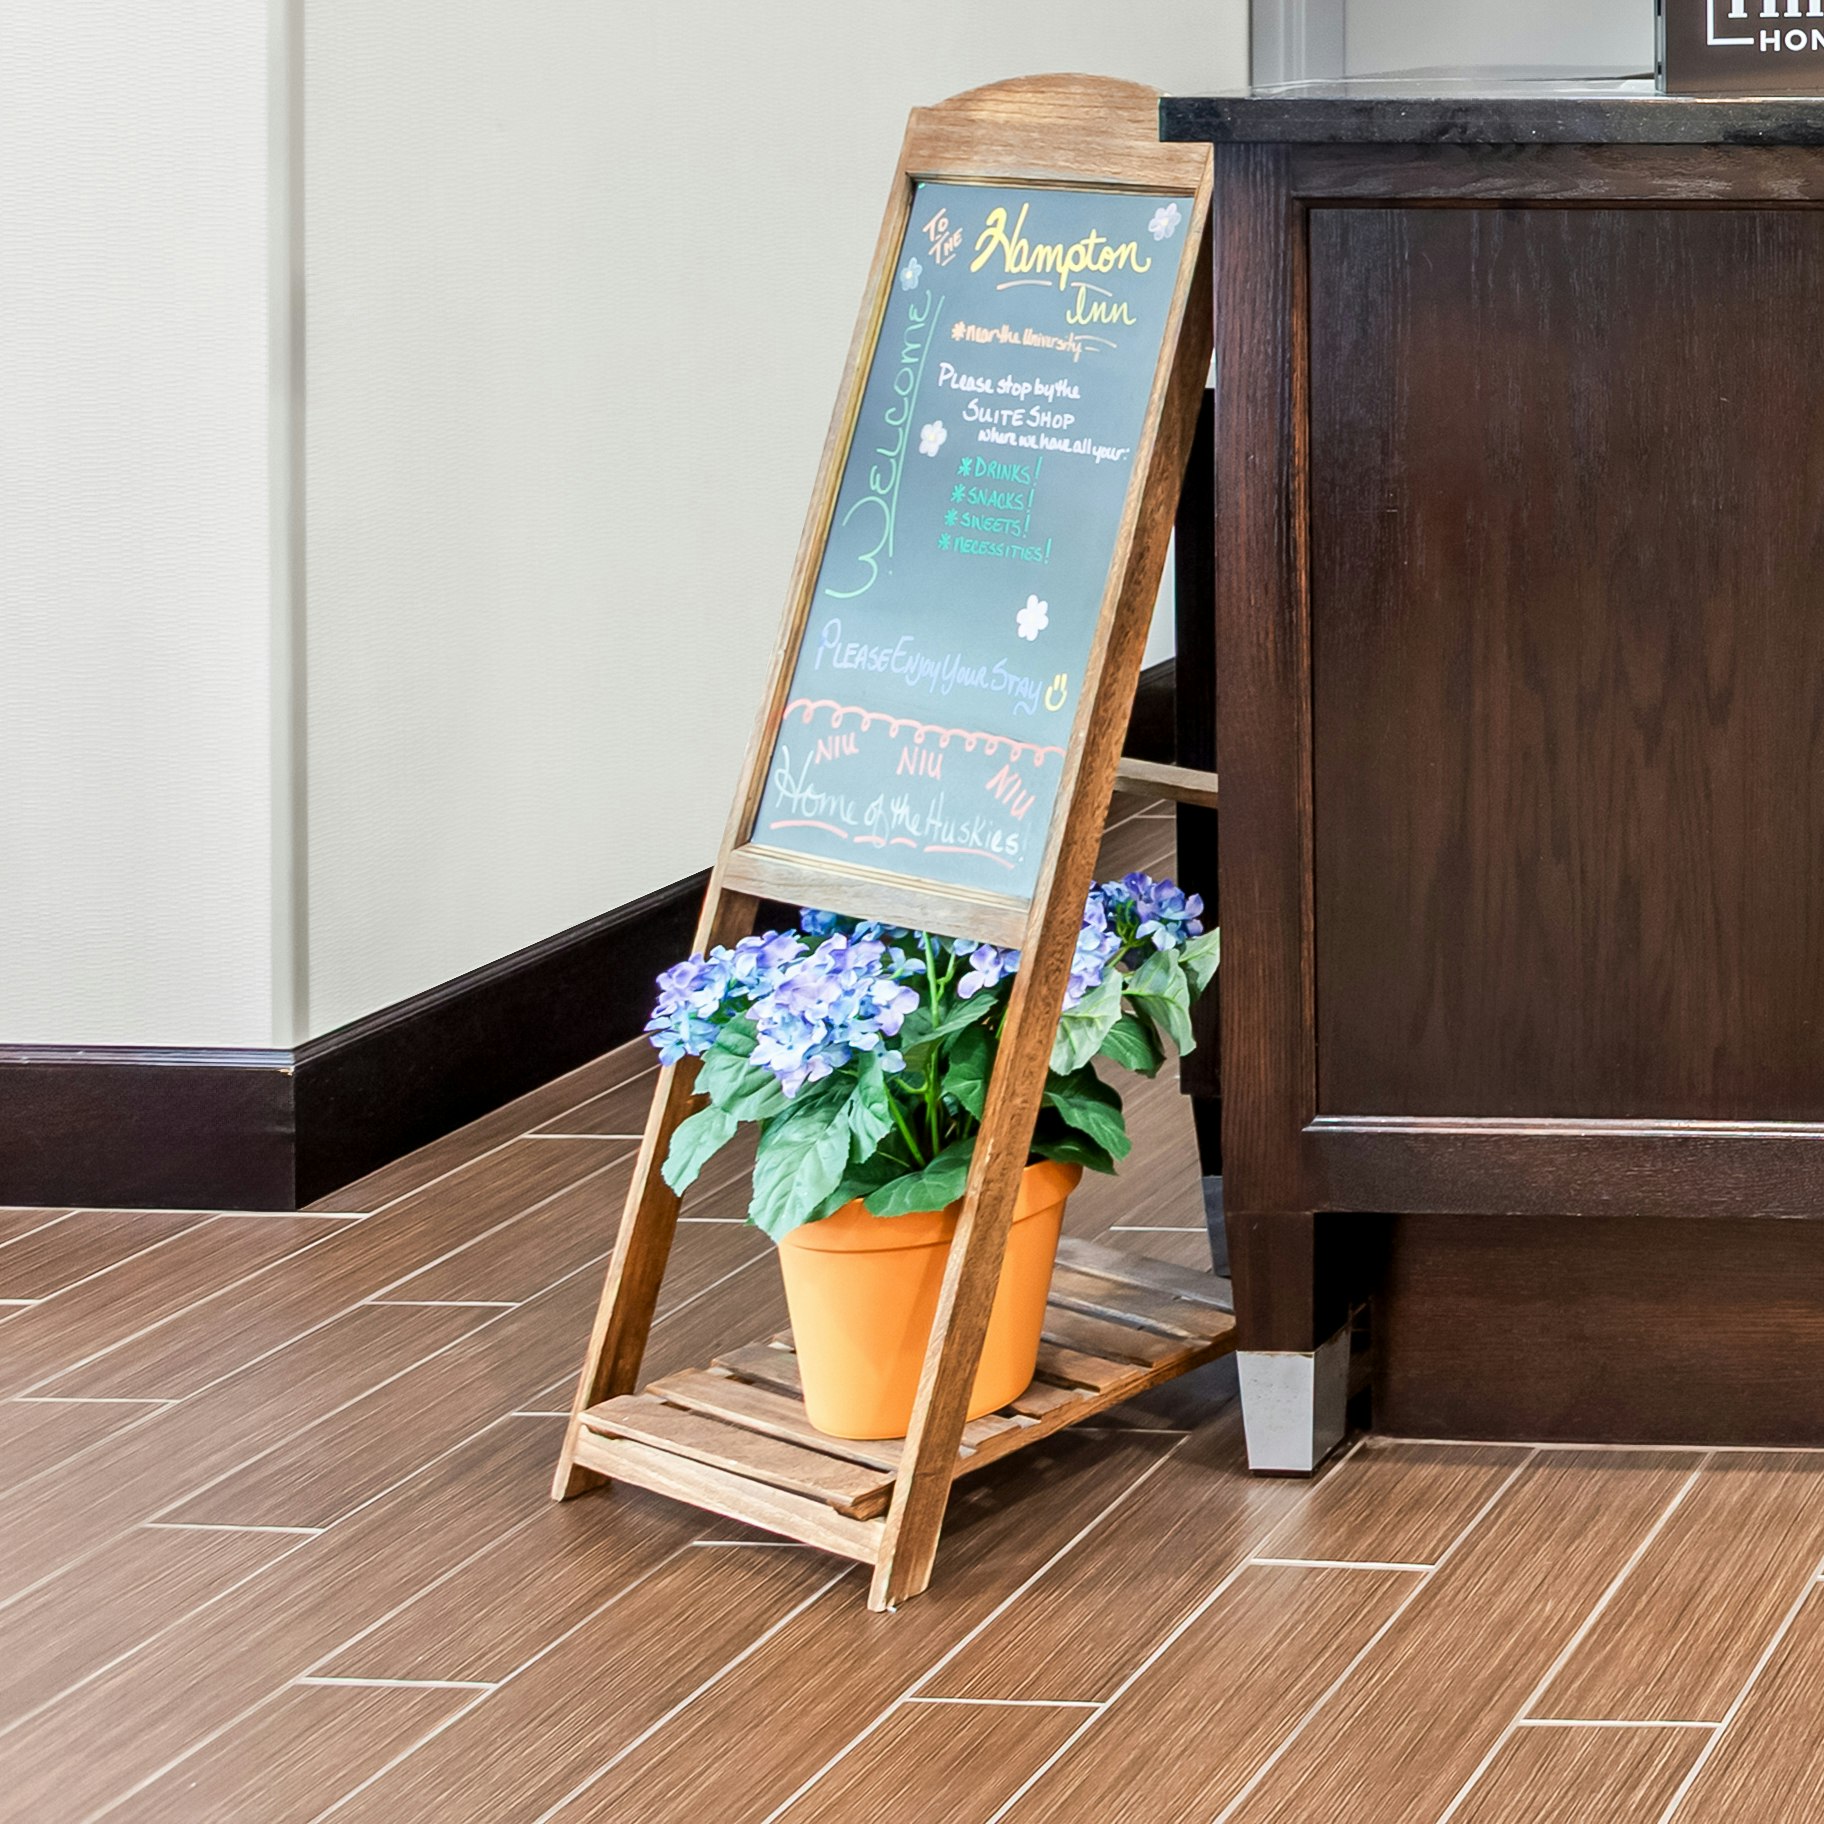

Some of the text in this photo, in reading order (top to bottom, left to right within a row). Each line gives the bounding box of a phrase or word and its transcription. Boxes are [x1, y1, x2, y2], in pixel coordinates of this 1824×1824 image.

[922, 207, 949, 242] TO
[928, 231, 963, 265] THE
[970, 202, 1151, 291] Hampton
[1066, 286, 1137, 325] Inn
[997, 375, 1032, 401] stop
[1034, 378, 1056, 402] by
[1055, 379, 1081, 399] the
[962, 398, 1075, 429] SUITE SHOP
[978, 427, 1017, 447] where
[1019, 436, 1038, 449] we
[1039, 433, 1072, 452] have
[1073, 438, 1091, 455] all
[815, 732, 859, 764] NIU
[896, 746, 943, 780] NIU
[774, 745, 858, 825] Home
[864, 793, 890, 848] of
[891, 793, 922, 836] the
[985, 764, 1035, 820] NIU
